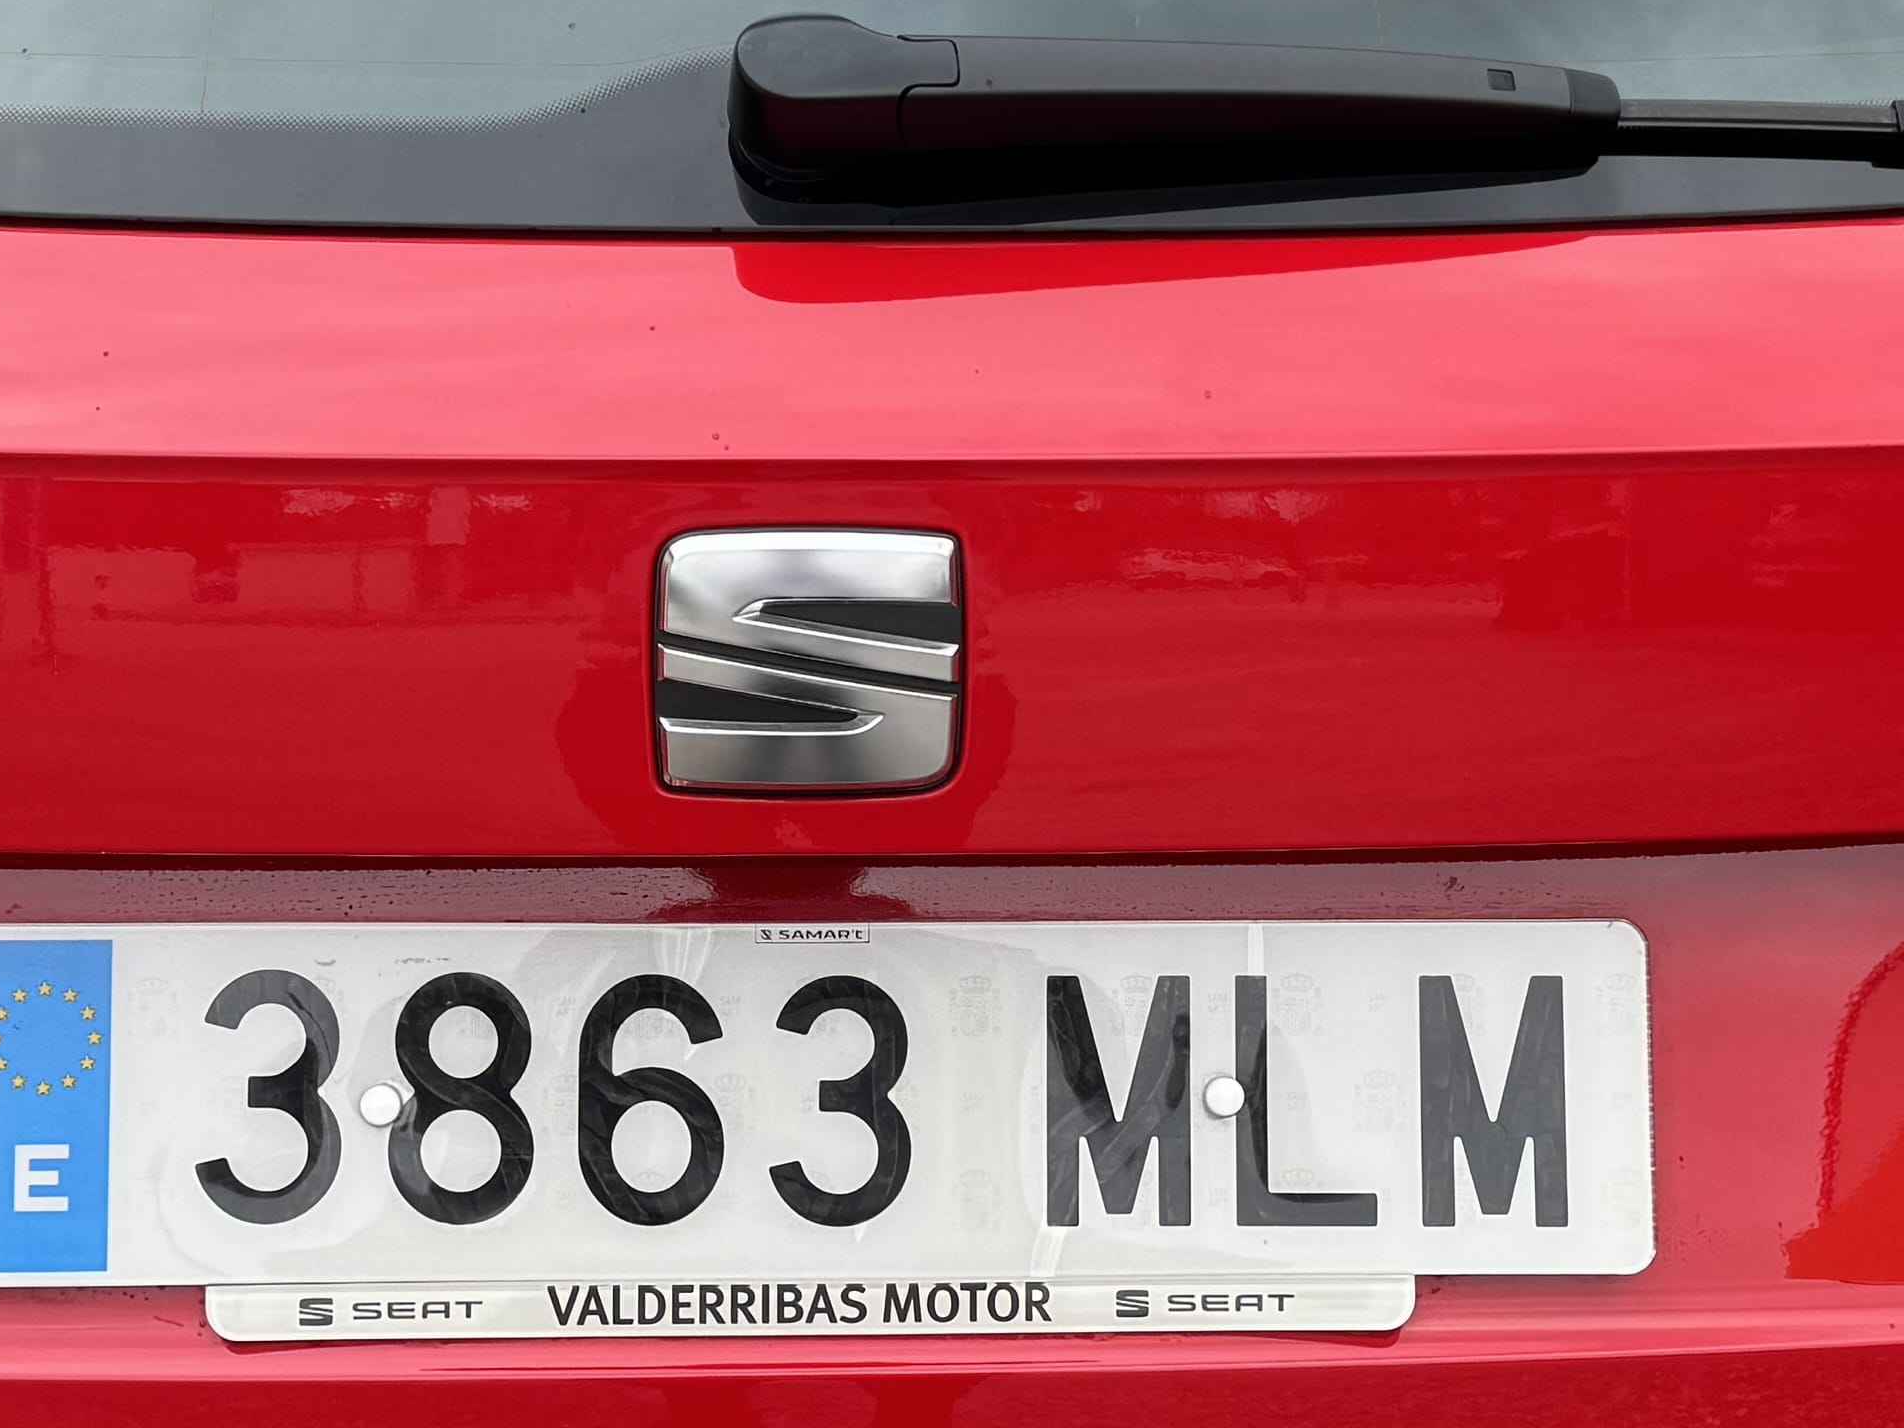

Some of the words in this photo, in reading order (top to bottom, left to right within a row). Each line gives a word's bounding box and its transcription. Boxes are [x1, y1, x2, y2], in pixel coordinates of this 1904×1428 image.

[195, 969, 911, 1227] 3863
[1046, 975, 1569, 1227] MLM
[12, 1143, 71, 1213] E
[352, 1299, 483, 1321] SEAT
[547, 1283, 866, 1328] VALDERRIBAS
[882, 1281, 1053, 1324] MOTOR
[1167, 1292, 1296, 1314] SEAT
